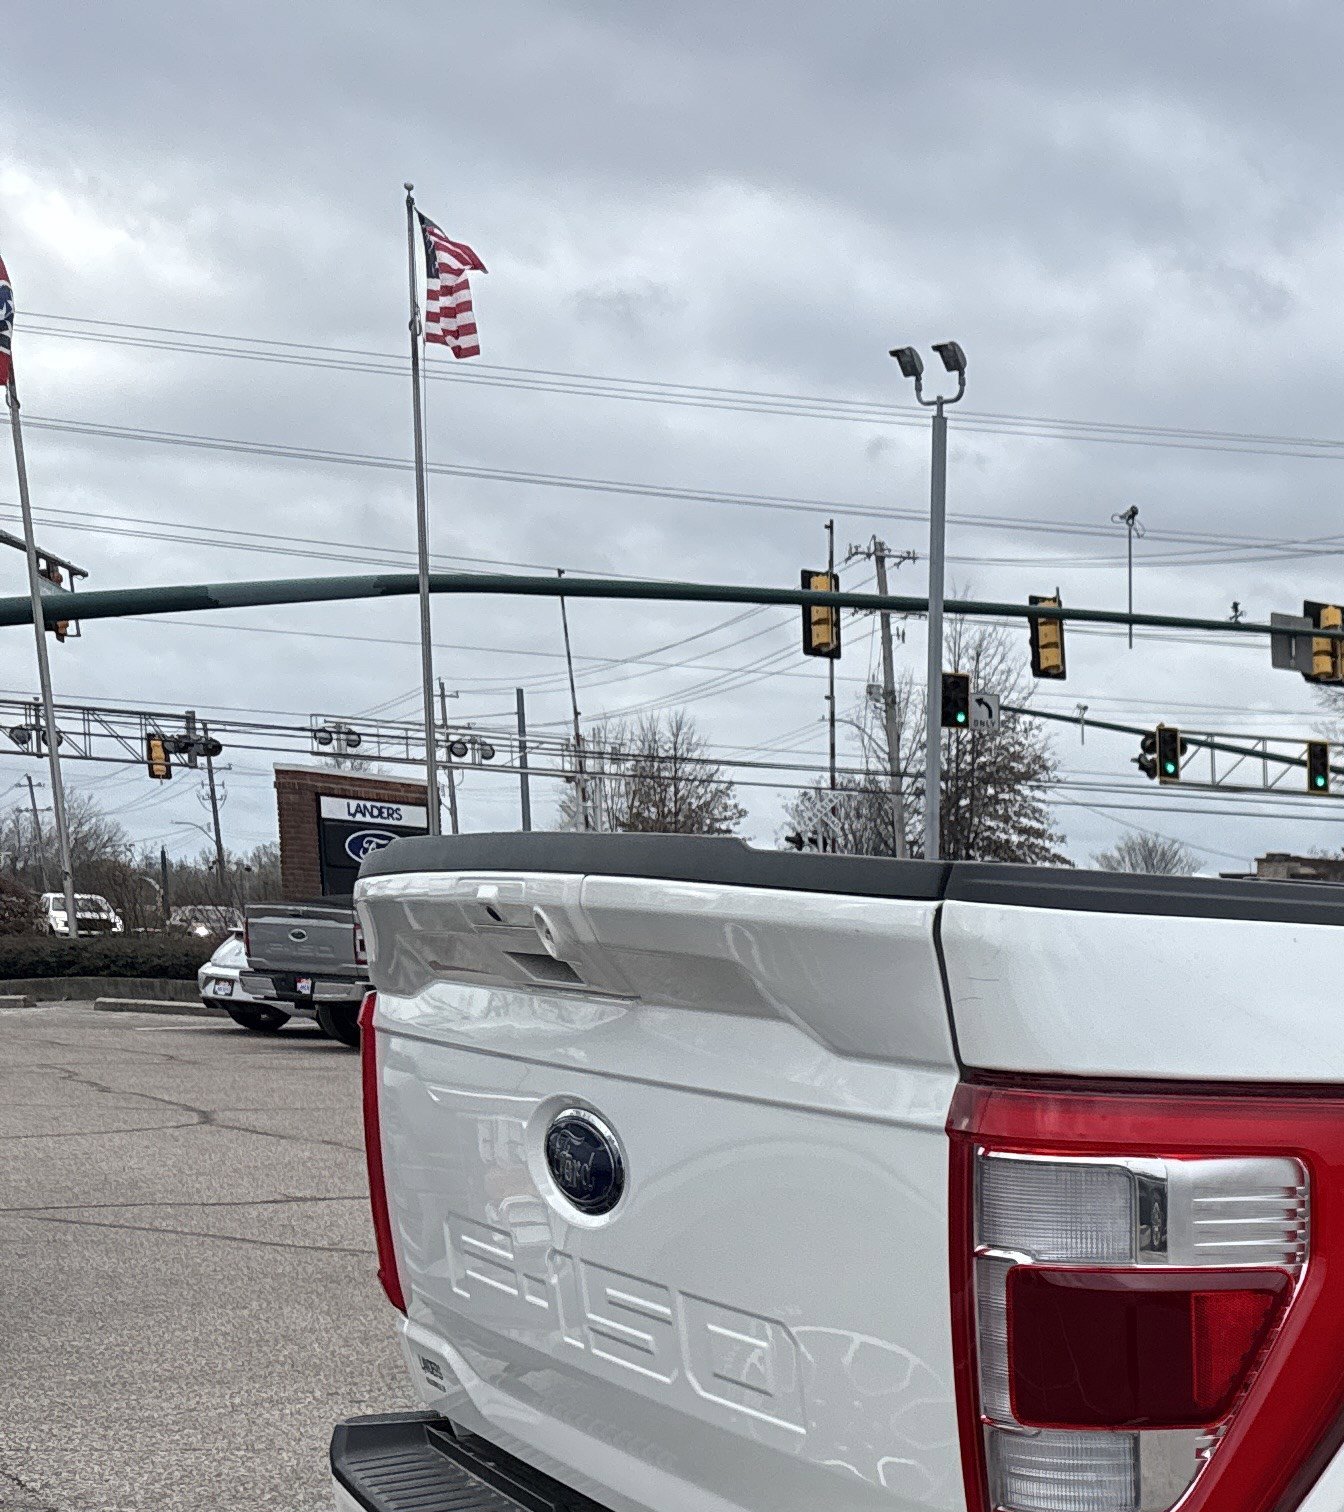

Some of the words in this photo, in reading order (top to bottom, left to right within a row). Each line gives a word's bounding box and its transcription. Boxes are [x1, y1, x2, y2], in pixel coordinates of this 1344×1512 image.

[346, 802, 403, 821] LANDERS
[549, 1129, 597, 1192] Ford
[444, 1211, 807, 1434] F-150
